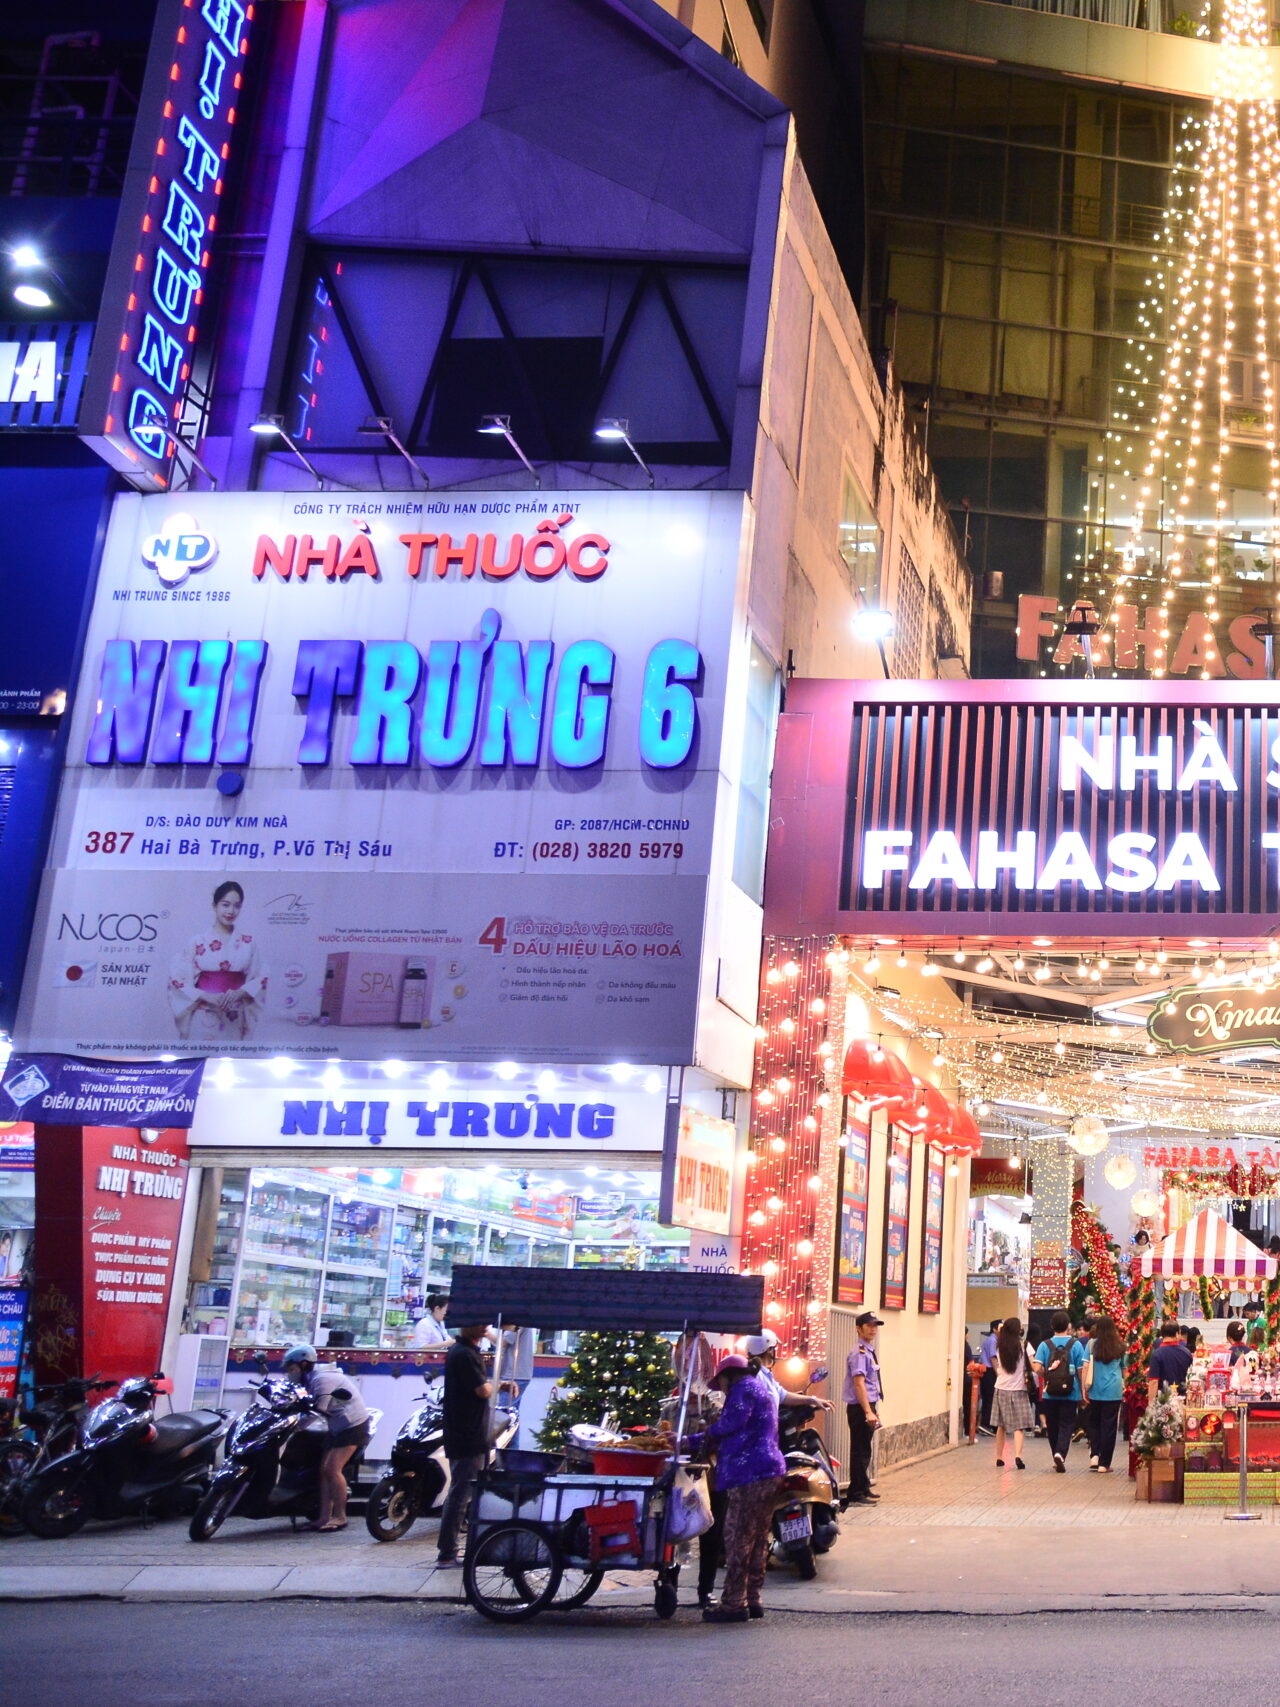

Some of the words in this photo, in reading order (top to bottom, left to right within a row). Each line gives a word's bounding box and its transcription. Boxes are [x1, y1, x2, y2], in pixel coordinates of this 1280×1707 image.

[294, 502, 323, 515] CÔNG
[328, 504, 342, 514] TY
[346, 501, 382, 514] TRÁCH
[386, 501, 423, 515] NHIỆM
[427, 501, 450, 514] HỮU
[454, 503, 477, 516] HẠN
[481, 501, 512, 516] DƯỢC
[515, 498, 548, 514] PHẨM
[552, 503, 581, 514] ATNT
[152, 535, 206, 559] NT
[252, 519, 379, 580] NHÀ
[399, 513, 610, 580] THUỐC
[172, 590, 202, 601] SINCE
[206, 591, 231, 602] 1986
[86, 639, 269, 797] NHỊ
[291, 607, 617, 769] TRƯNG
[639, 638, 703, 769] 6
[1060, 720, 1239, 793] NHÀ
[145, 816, 171, 828] D/S:
[175, 813, 201, 828] ĐÀO
[205, 816, 231, 828] DUY
[235, 816, 258, 828] KIM
[263, 813, 288, 828] NGÀ
[555, 819, 575, 831] GP:
[580, 819, 690, 831] 2087/HCM-CCHND
[85, 831, 134, 854] 387
[141, 839, 171, 855] Hai
[178, 838, 200, 855] Bà
[210, 839, 265, 859] Trưng,
[273, 840, 315, 856] P.Võ
[324, 840, 350, 860] Thị
[358, 838, 392, 857] Sáu
[494, 842, 524, 858] ĐT:
[532, 842, 579, 862] (028)
[587, 842, 631, 859] 3820
[639, 842, 684, 859] 5979
[861, 829, 1220, 893] FAHASA
[478, 917, 507, 954] 4
[610, 924, 629, 935] DA
[513, 937, 552, 955] DẤU
[556, 939, 597, 959] HIỆU
[602, 940, 638, 957] LÃO
[642, 940, 682, 957] HOÁ
[101, 961, 122, 973] SẢN
[124, 961, 151, 973] XUẤT
[101, 976, 117, 987] TẠI
[119, 975, 147, 987] NHẬT
[359, 972, 394, 993] SPA
[109, 1083, 131, 1094] HÀNG
[132, 1083, 149, 1096] VIỆT
[149, 1086, 168, 1095] NAM
[42, 1091, 74, 1109] ĐIỂM
[76, 1095, 100, 1111] BÁN
[103, 1094, 144, 1112] THUỐC
[145, 1098, 175, 1112] BÌNH
[174, 1092, 195, 1112] ỔN
[281, 1099, 391, 1145] NHỊ
[406, 1093, 616, 1138] TRƯNG
[112, 1144, 138, 1161] NHÀ
[141, 1149, 177, 1167] THUỐC
[1143, 1147, 1237, 1168] FAHASA
[98, 1165, 131, 1198] NHỊ
[132, 1169, 184, 1199] TRƯNG
[702, 1244, 728, 1257] NHÀ
[136, 1272, 143, 1285] Y
